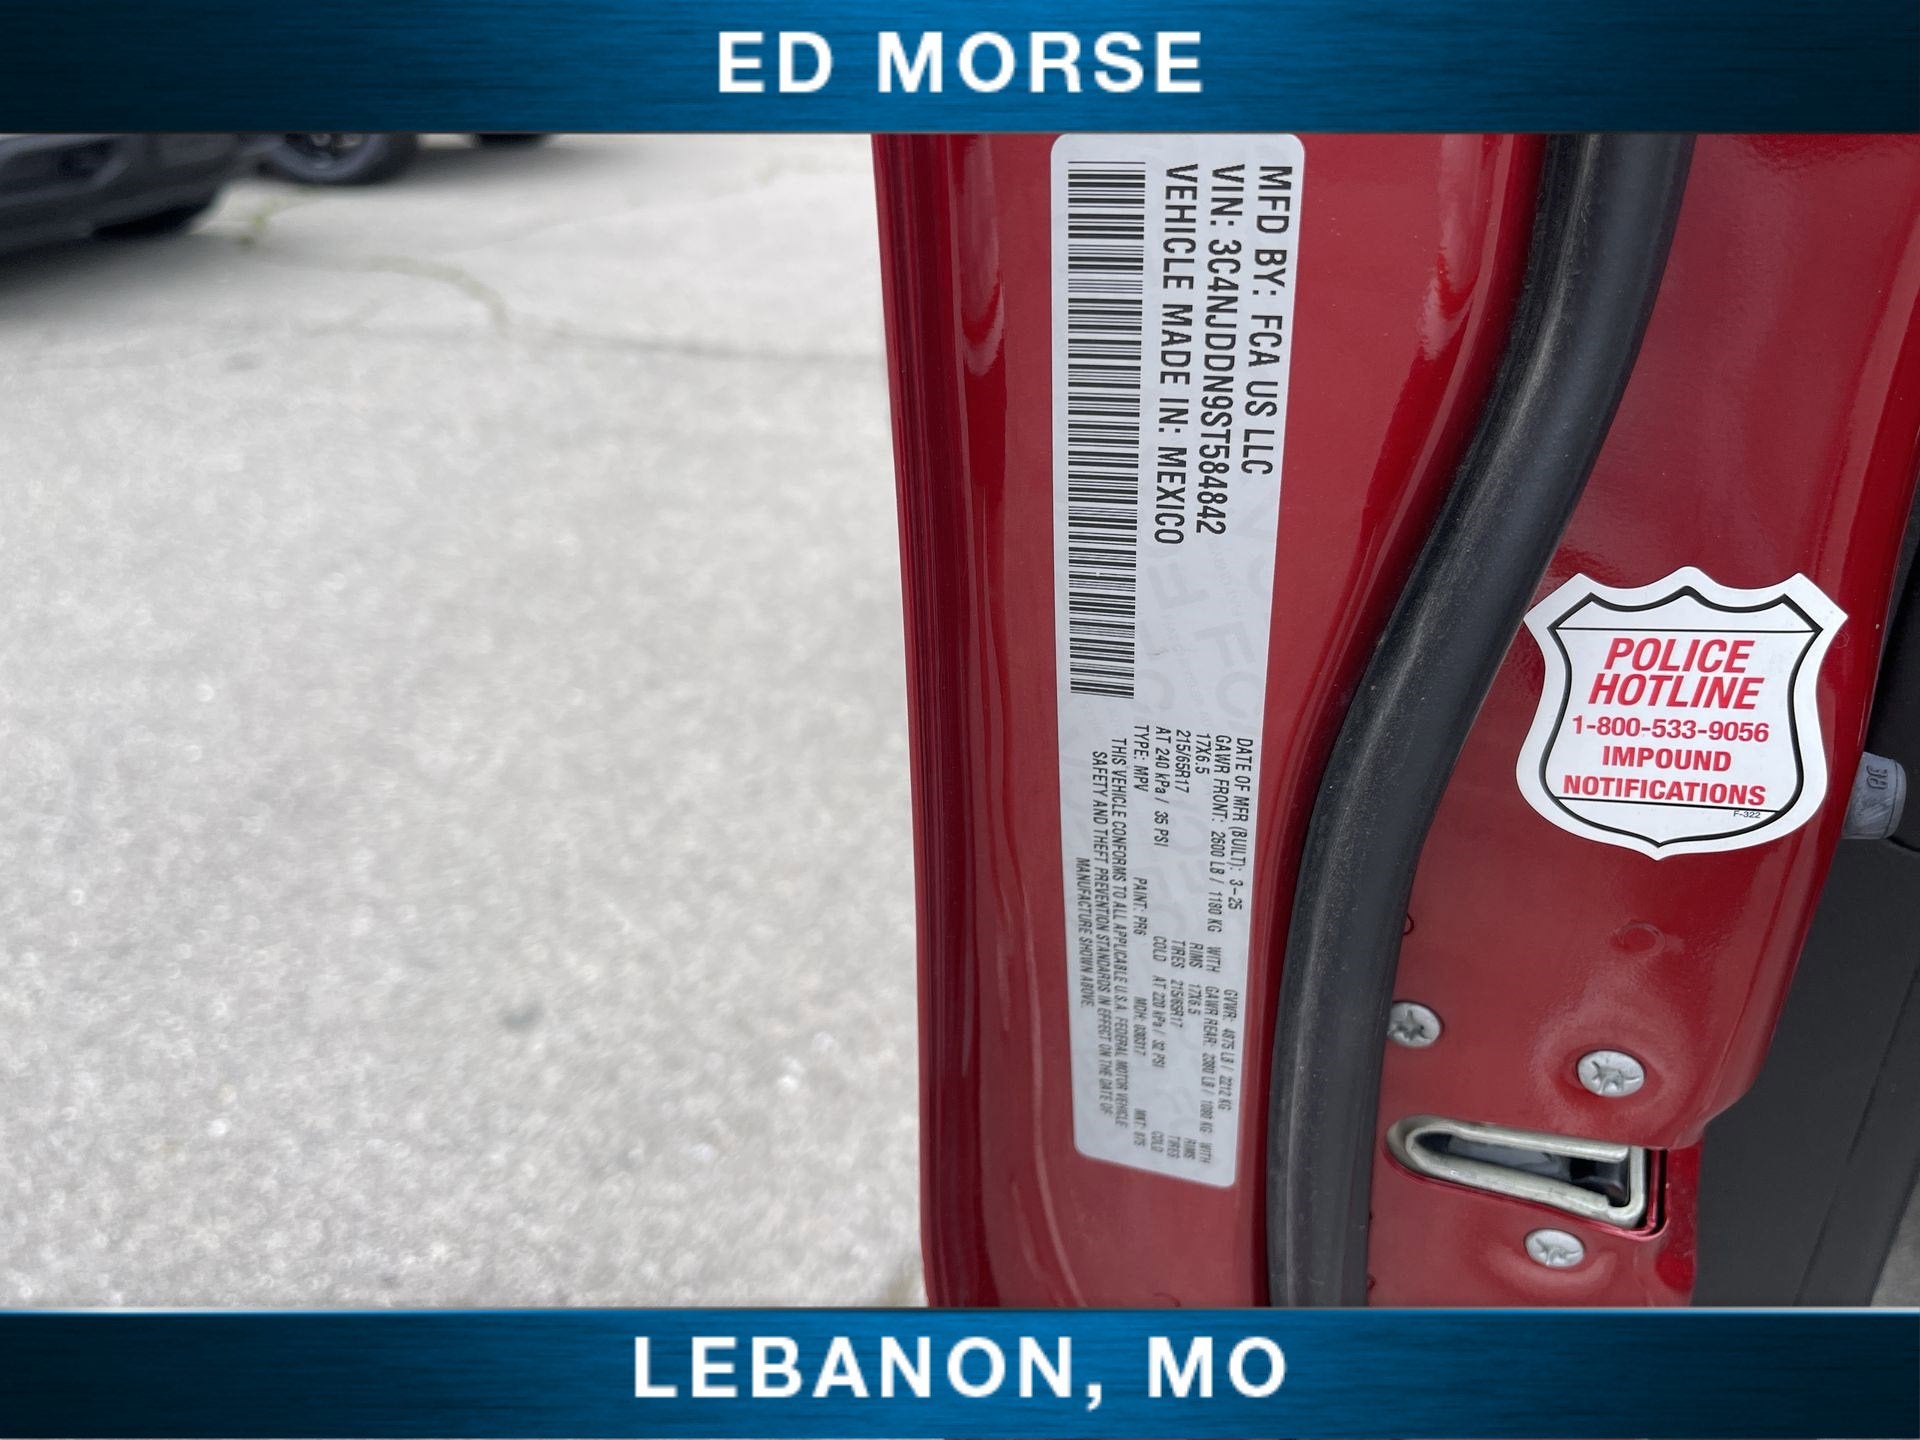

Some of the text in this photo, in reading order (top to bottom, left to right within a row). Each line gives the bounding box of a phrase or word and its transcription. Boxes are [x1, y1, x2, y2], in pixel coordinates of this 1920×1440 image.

[1241, 165, 1292, 475] MFD BY: FCA US LLC
[1154, 164, 1198, 545] VEHICLE MADE IN: MEXICO
[1195, 164, 1245, 535] VIN: 3C4NJDDN9ST584842
[1603, 637, 1755, 674] POLICE
[1588, 674, 1765, 710] HOTLINE
[1155, 726, 1171, 743] AT
[1572, 716, 1770, 743] 1-800-533-9056
[1134, 725, 1149, 792] TYPE: MPV
[1155, 748, 1170, 769] 240
[1175, 729, 1191, 793] 215/65R17
[1196, 733, 1211, 774] 17X6.5
[1214, 735, 1231, 773] GAWR
[1235, 738, 1253, 771] DATE
[1602, 745, 1732, 772] IMPOUND
[1155, 773, 1170, 794] kPa
[1234, 776, 1250, 791] OF
[1563, 775, 1767, 806] NOTIFICATIONS
[1212, 779, 1229, 822] FRONT:
[1232, 796, 1249, 821] MFR
[1154, 811, 1168, 825] 35
[1733, 810, 1762, 819] F-322
[1154, 828, 1168, 847] PSI
[1210, 831, 1225, 857] 2600
[1227, 827, 1247, 871] (BUILT):
[1210, 861, 1225, 874] LB
[1133, 877, 1147, 936] PAINT: PR6
[1208, 891, 1222, 915] 1180
[1076, 858, 1095, 1008] MANUFACTURE SHOWN ABOVE.
[1092, 751, 1112, 1115] SAFETY AND THEFT PREVENTION STANDARDS IN EFFECT ON THE DATE OF
[1112, 738, 1128, 1127] THIS VEHICLE CONFORMS TO ALL APPLICABLE U.S.A. FEDERAL MOTOR VEHICLE
[1207, 919, 1222, 932] KG
[1153, 936, 1166, 961] COLD
[1171, 940, 1185, 968] TIRES
[1189, 943, 1203, 968] RIMS
[1206, 947, 1221, 972] WITH
[1153, 976, 1166, 989] AT
[1133, 997, 1146, 1020] MDH:
[1152, 992, 1165, 1007] 220
[1171, 979, 1183, 1028] 215/65R17
[1188, 984, 1200, 1015] 17X6.5
[1204, 986, 1219, 1015] GAWR
[1222, 989, 1237, 1022] GVWR:
[1152, 1010, 1165, 1027] kPa
[1203, 1018, 1218, 1048] REAR:
[1221, 1029, 1235, 1049] 4875
[1152, 1053, 1165, 1068] PSI
[1221, 1052, 1234, 1063] LB
[1201, 1076, 1214, 1087] LB
[1218, 1098, 1232, 1110] KG
[1199, 1121, 1212, 1133] KG
[1151, 1131, 1164, 1153] COLD
[1167, 1136, 1180, 1159] TIRES
[1184, 1138, 1196, 1160] RIMS
[1199, 1142, 1212, 1163] WITH
